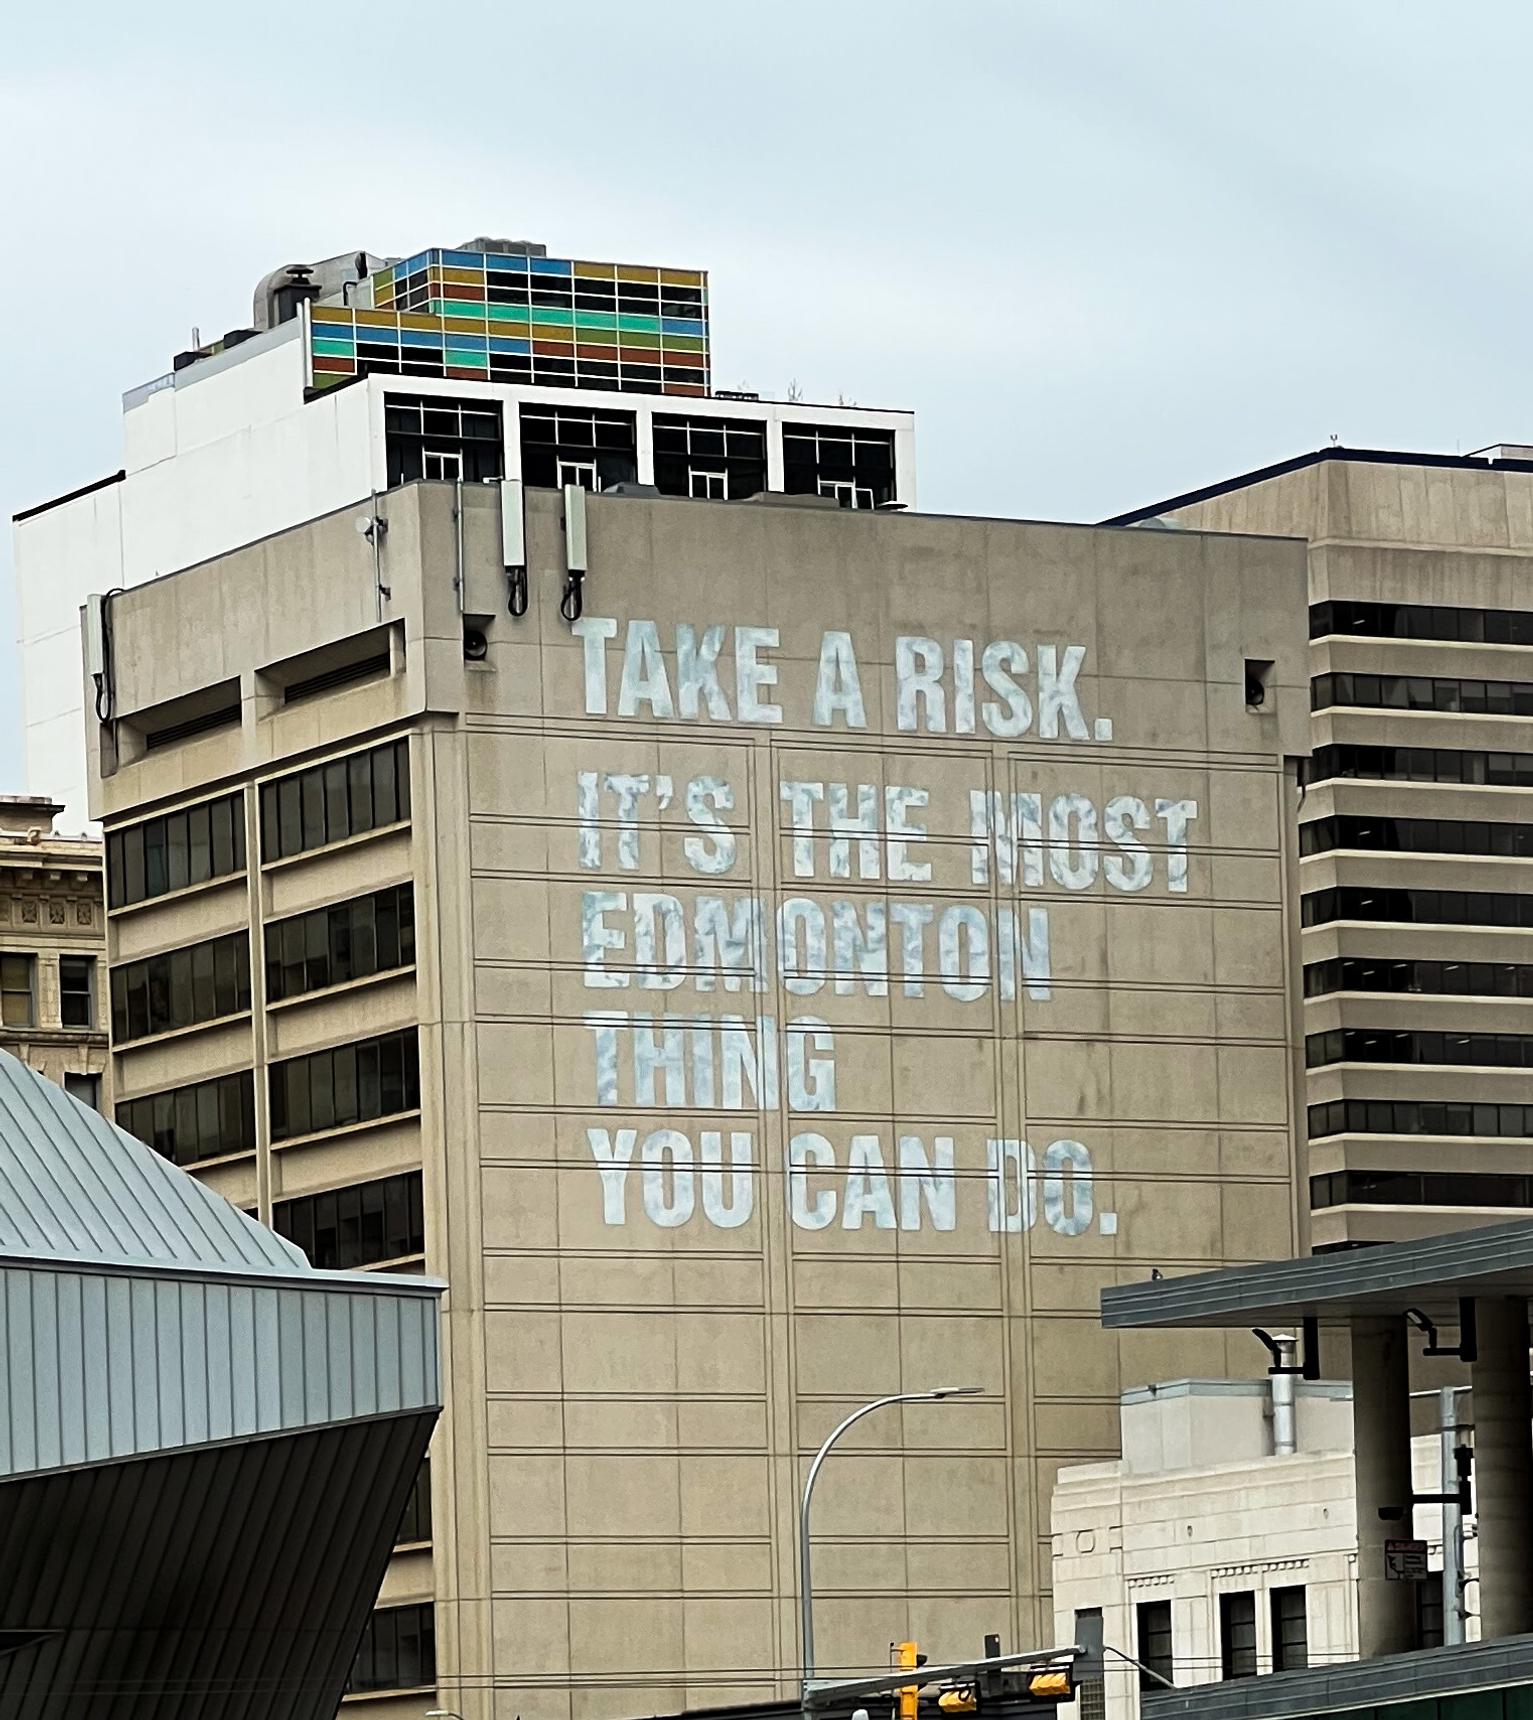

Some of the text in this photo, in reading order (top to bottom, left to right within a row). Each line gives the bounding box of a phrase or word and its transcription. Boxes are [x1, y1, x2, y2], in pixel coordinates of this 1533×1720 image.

[572, 618, 1112, 741] TAKE A RISK.
[578, 771, 1197, 892] IT'S THE MOST
[581, 891, 1052, 1001] EDMONTON
[583, 1011, 837, 1112] THING
[587, 1128, 1117, 1236] YOU CAN DO.
